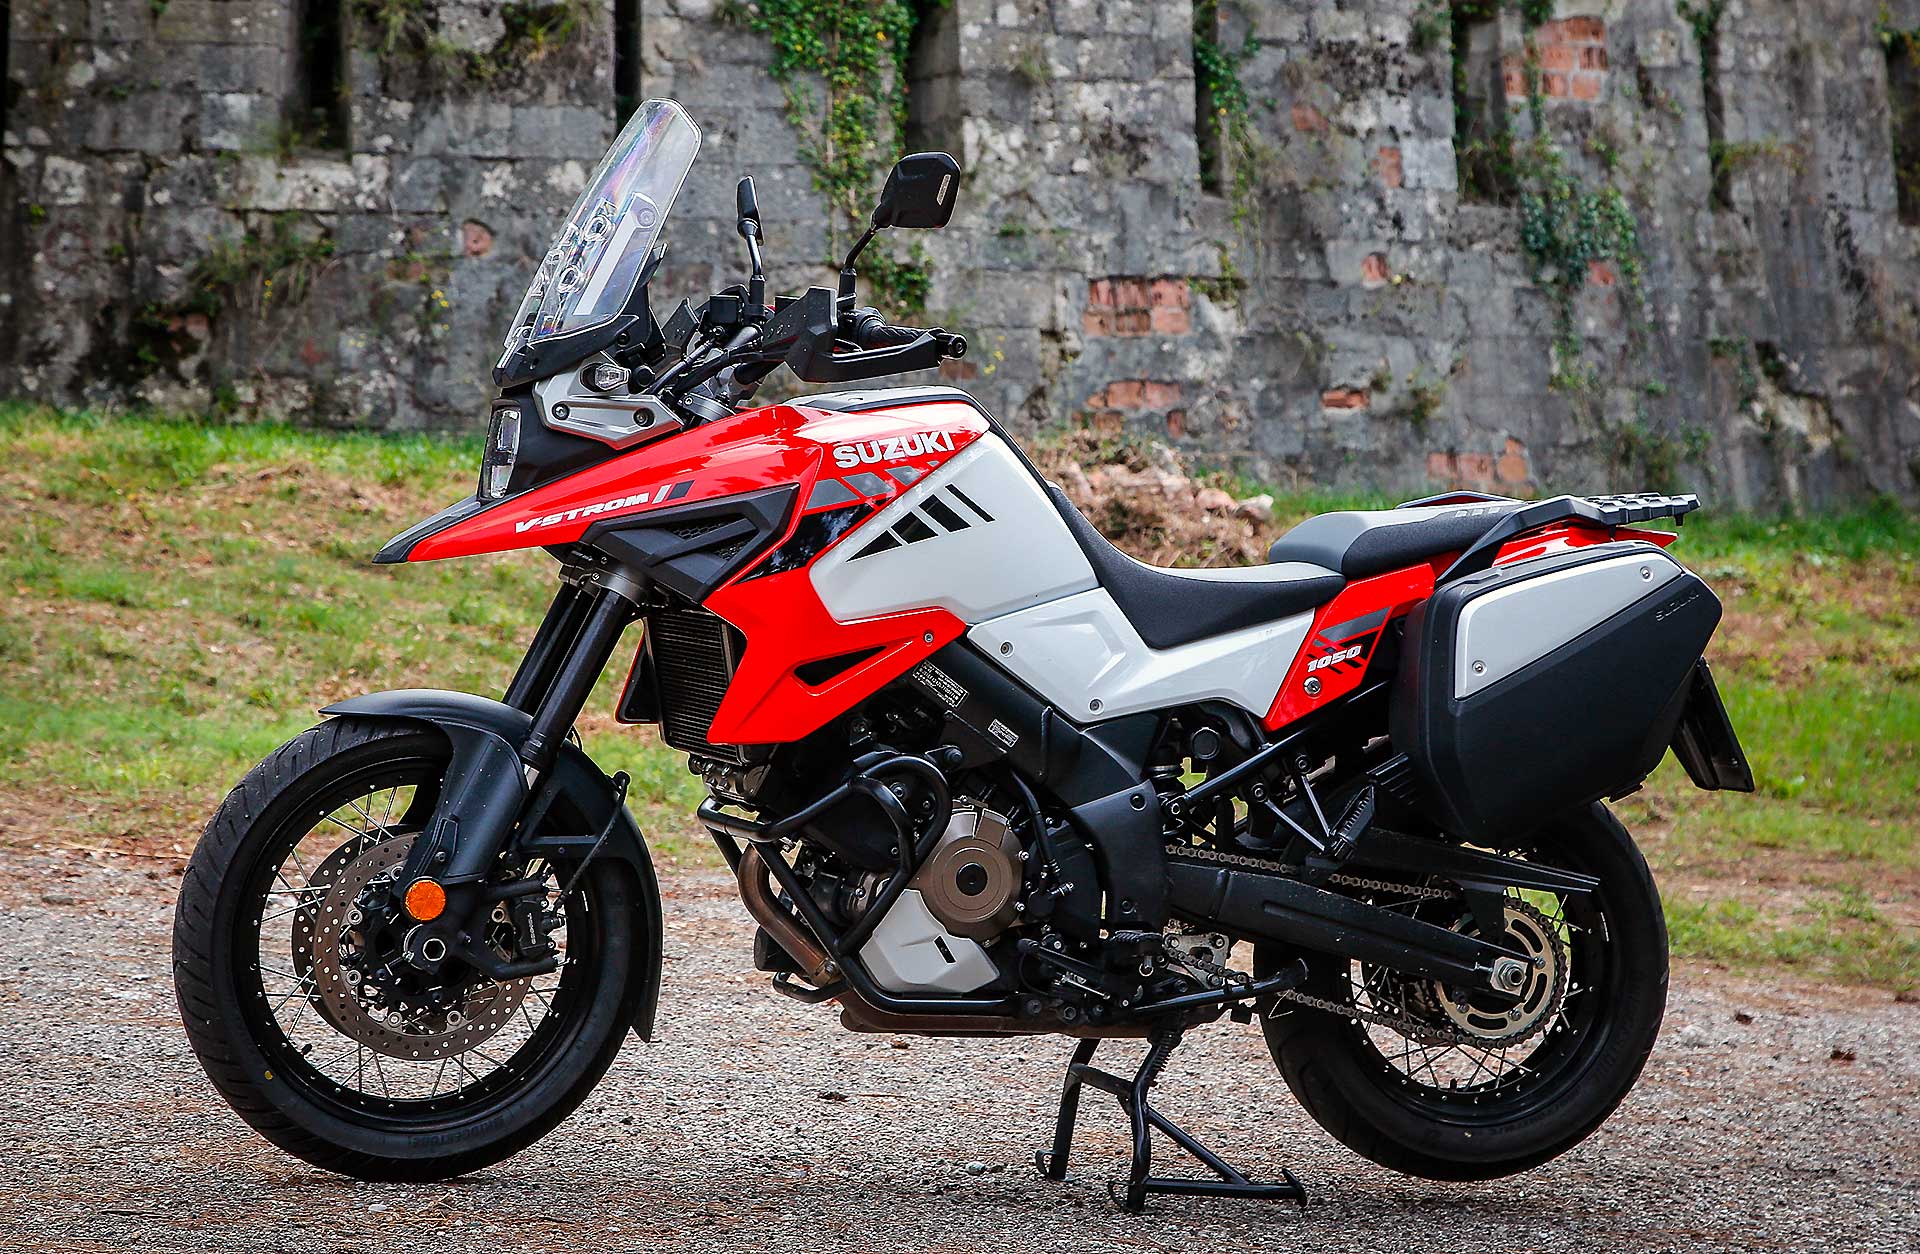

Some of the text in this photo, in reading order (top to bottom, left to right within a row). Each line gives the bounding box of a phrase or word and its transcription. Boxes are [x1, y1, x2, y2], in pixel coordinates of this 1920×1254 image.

[832, 430, 955, 468] SUZUKI
[514, 492, 651, 534] V-STROM
[1307, 645, 1362, 672] 1050
